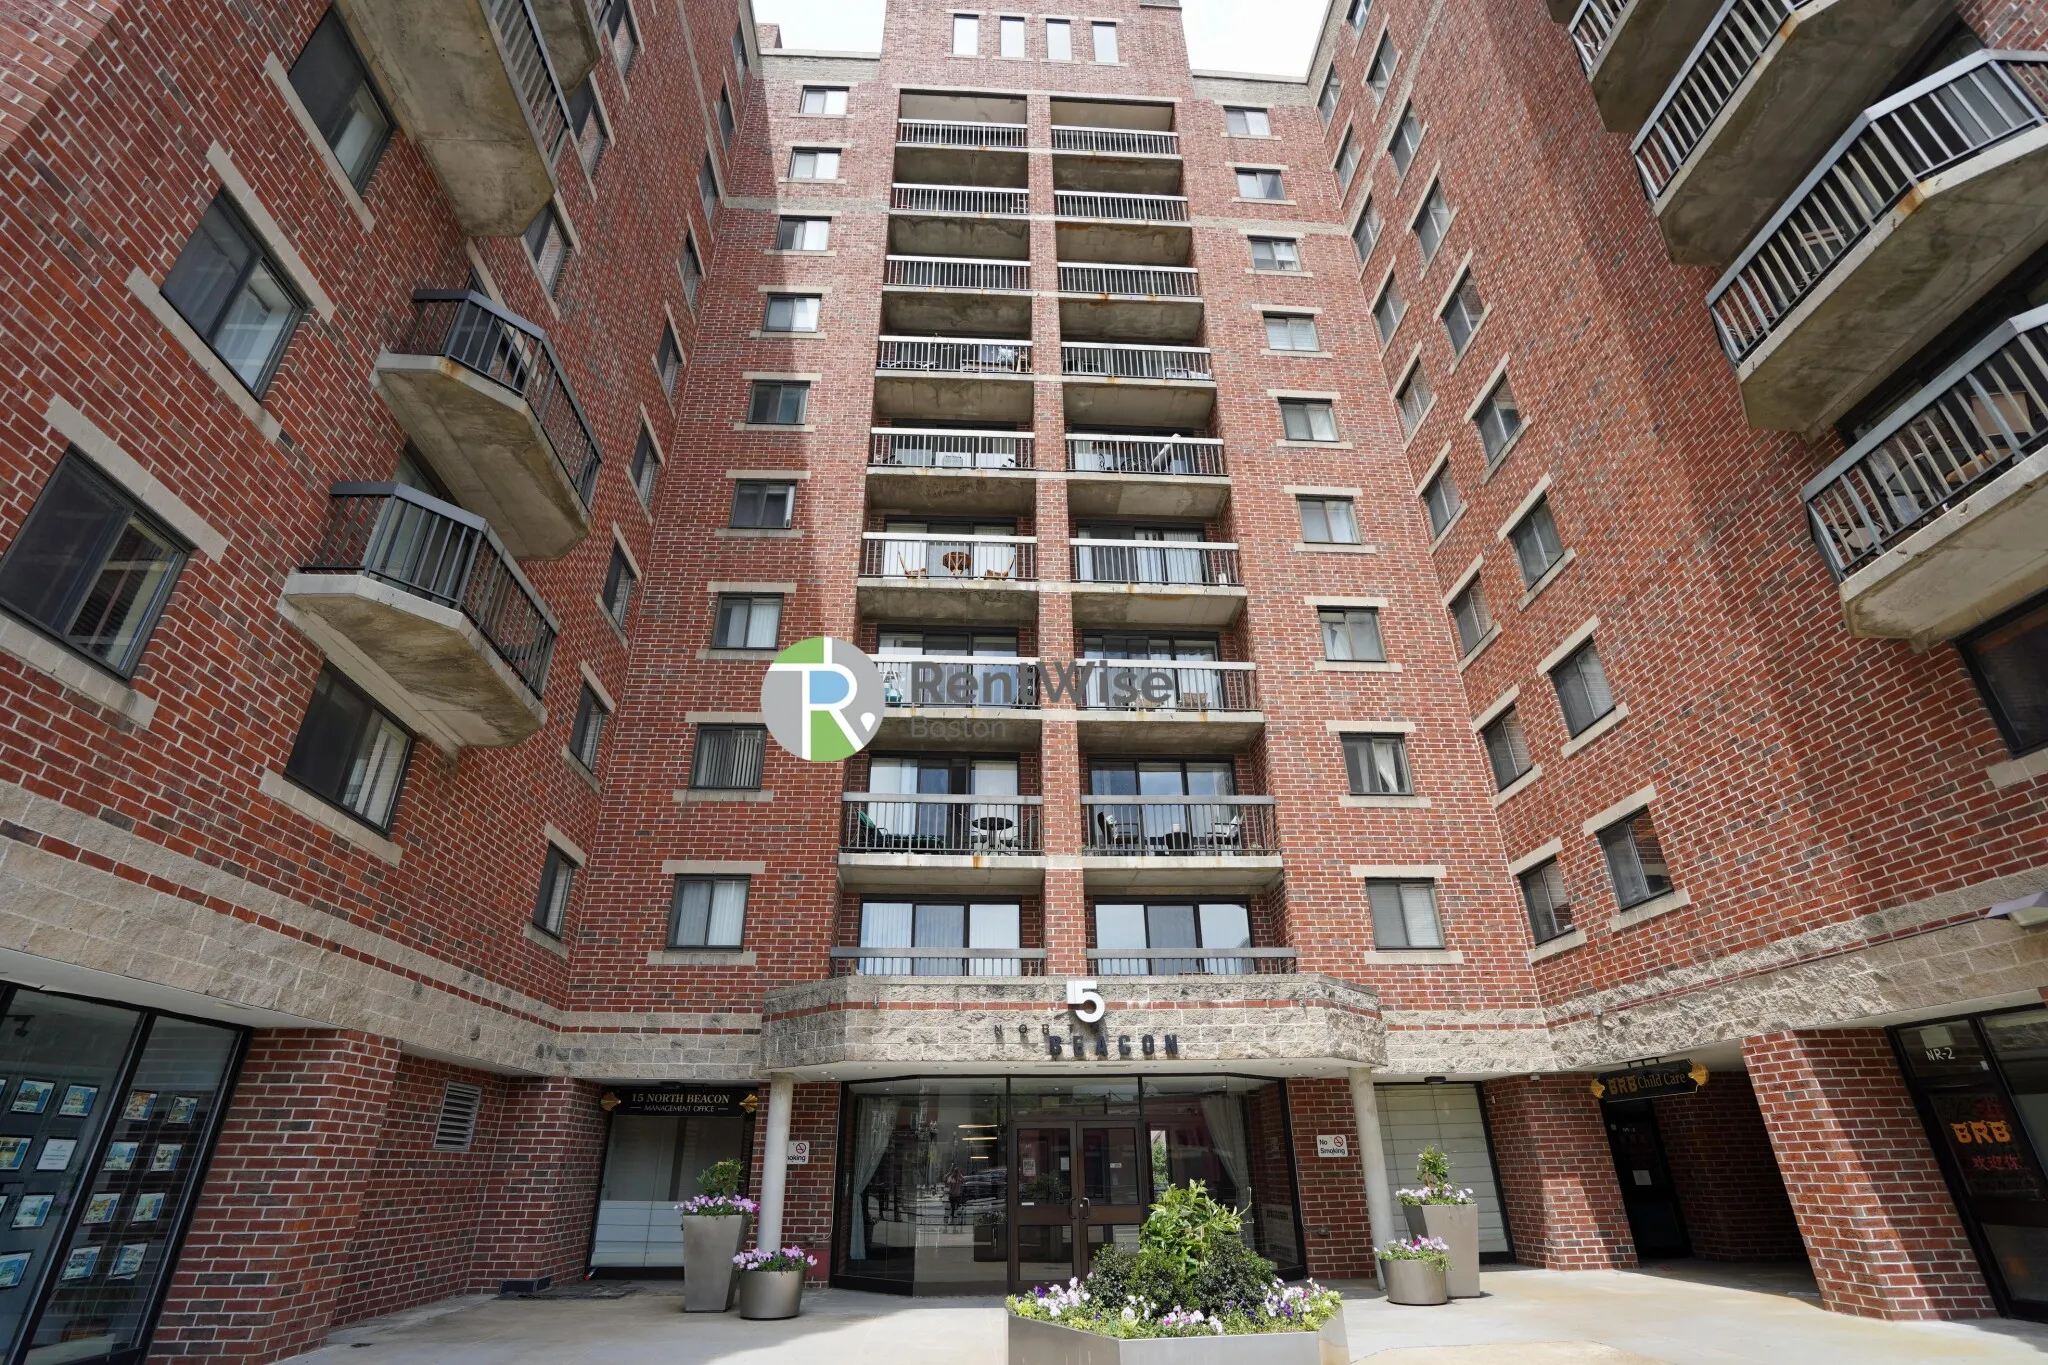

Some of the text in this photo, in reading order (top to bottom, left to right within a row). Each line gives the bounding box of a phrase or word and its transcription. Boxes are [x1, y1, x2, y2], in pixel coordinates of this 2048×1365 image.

[1066, 980, 1105, 1022] 5
[1049, 1034, 1179, 1057] BEACON
[1925, 1047, 1956, 1061] NR-2
[1607, 1072, 1686, 1095] BRB Child Care
[632, 1093, 730, 1104] 15 NORTH BEACON
[1950, 1120, 2011, 1144] BRB
[787, 1154, 806, 1162] oking
